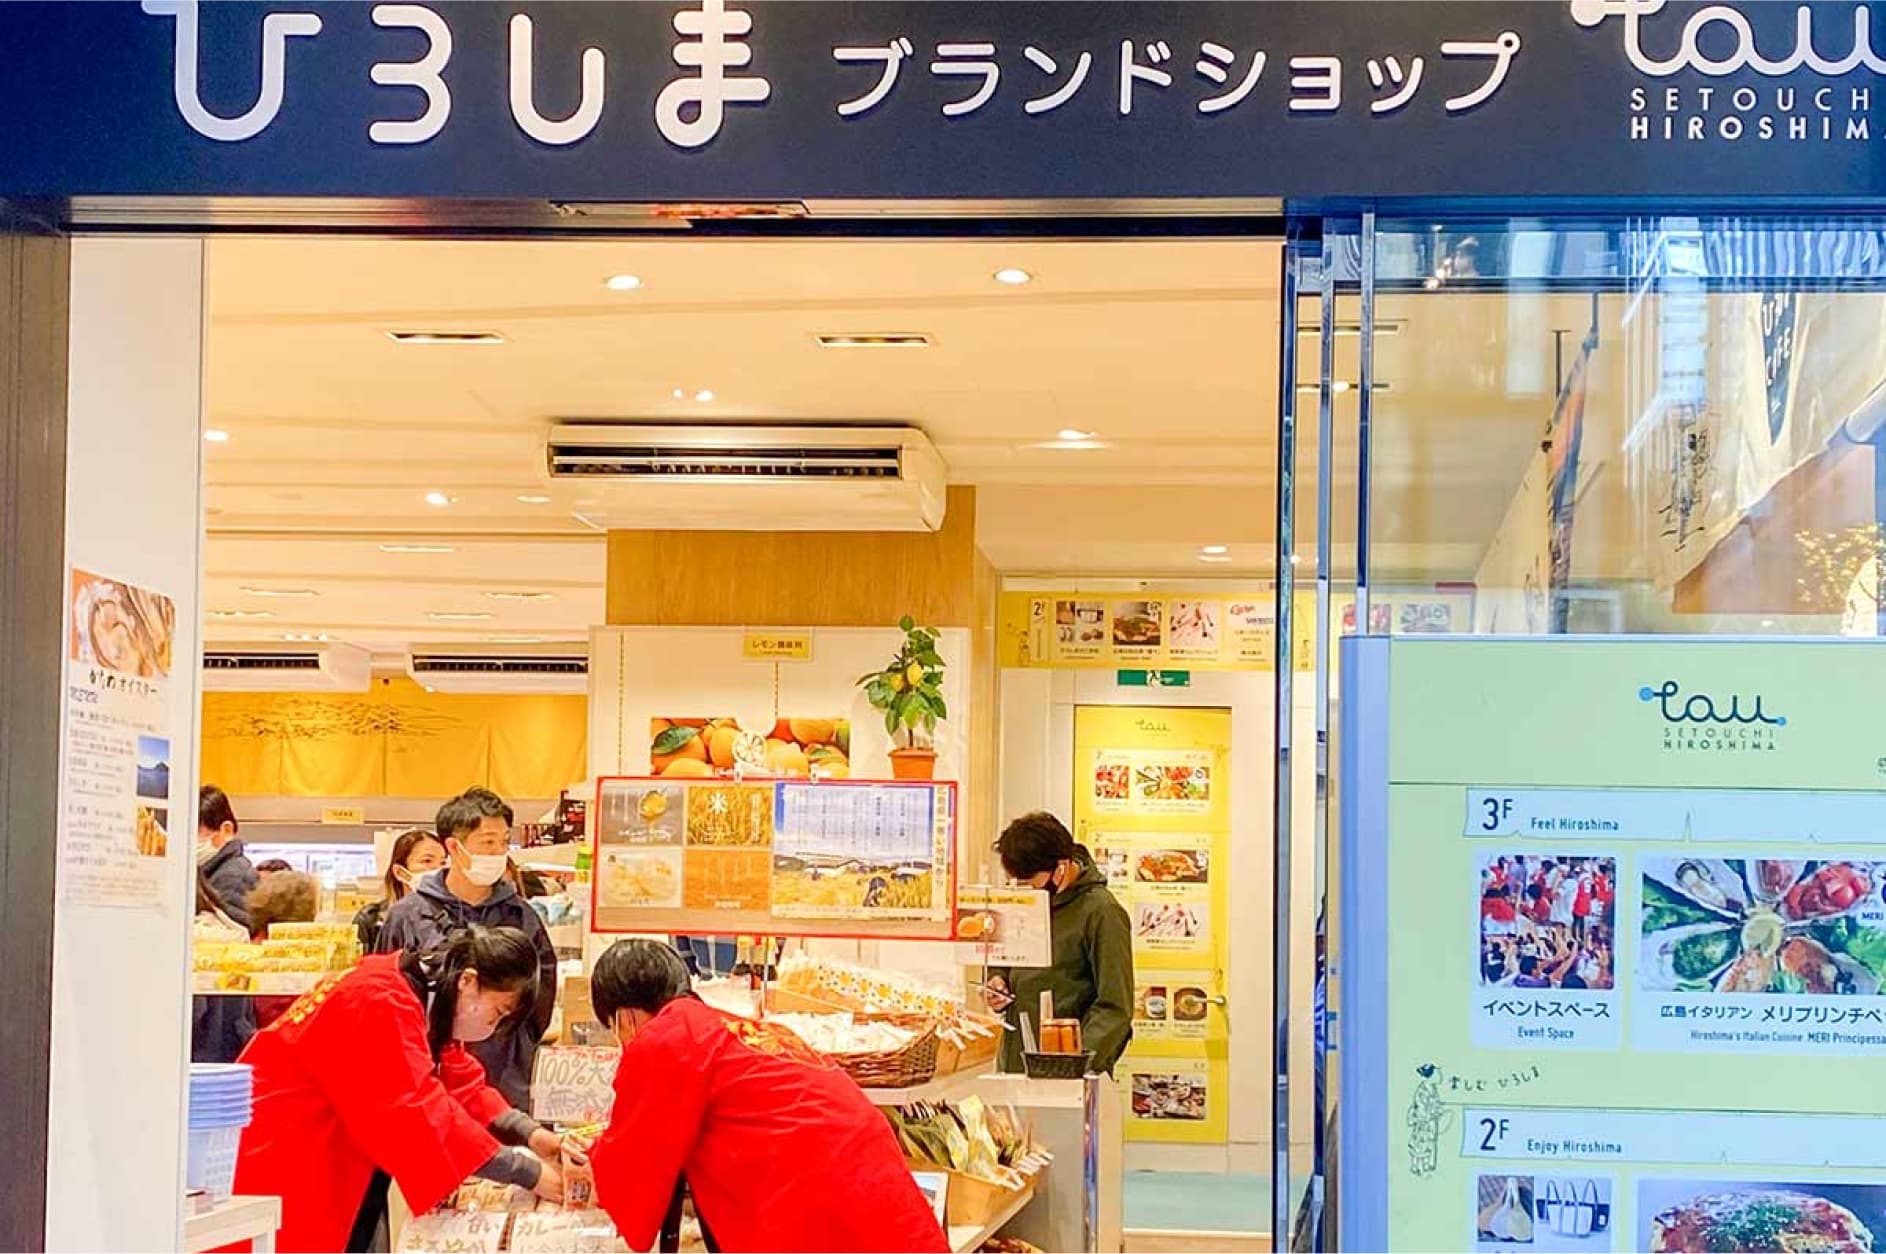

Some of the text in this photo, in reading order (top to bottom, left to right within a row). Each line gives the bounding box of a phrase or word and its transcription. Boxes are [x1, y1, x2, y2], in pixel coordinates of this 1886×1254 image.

[142, 0, 1522, 147] ひろしま ブランドショップ
[1630, 87, 1870, 112] SETOUCH
[1630, 116, 1886, 140] HIROSHIM
[1640, 680, 1787, 724] tau
[1664, 727, 1774, 738] SETOUCHI
[1663, 739, 1776, 750] HIROSHIMA
[1531, 817, 1619, 831] Feel Hiroshima
[1483, 1000, 1611, 1018] イベントスペース
[1660, 1005, 1886, 1023] 広島イタリアン メリプリンチペ
[1517, 1026, 1575, 1040] Event Space
[1808, 1031, 1831, 1044] MERI
[540, 1055, 618, 1086] 100%大
[1527, 1138, 1622, 1155] Enjoy Hiroshima
